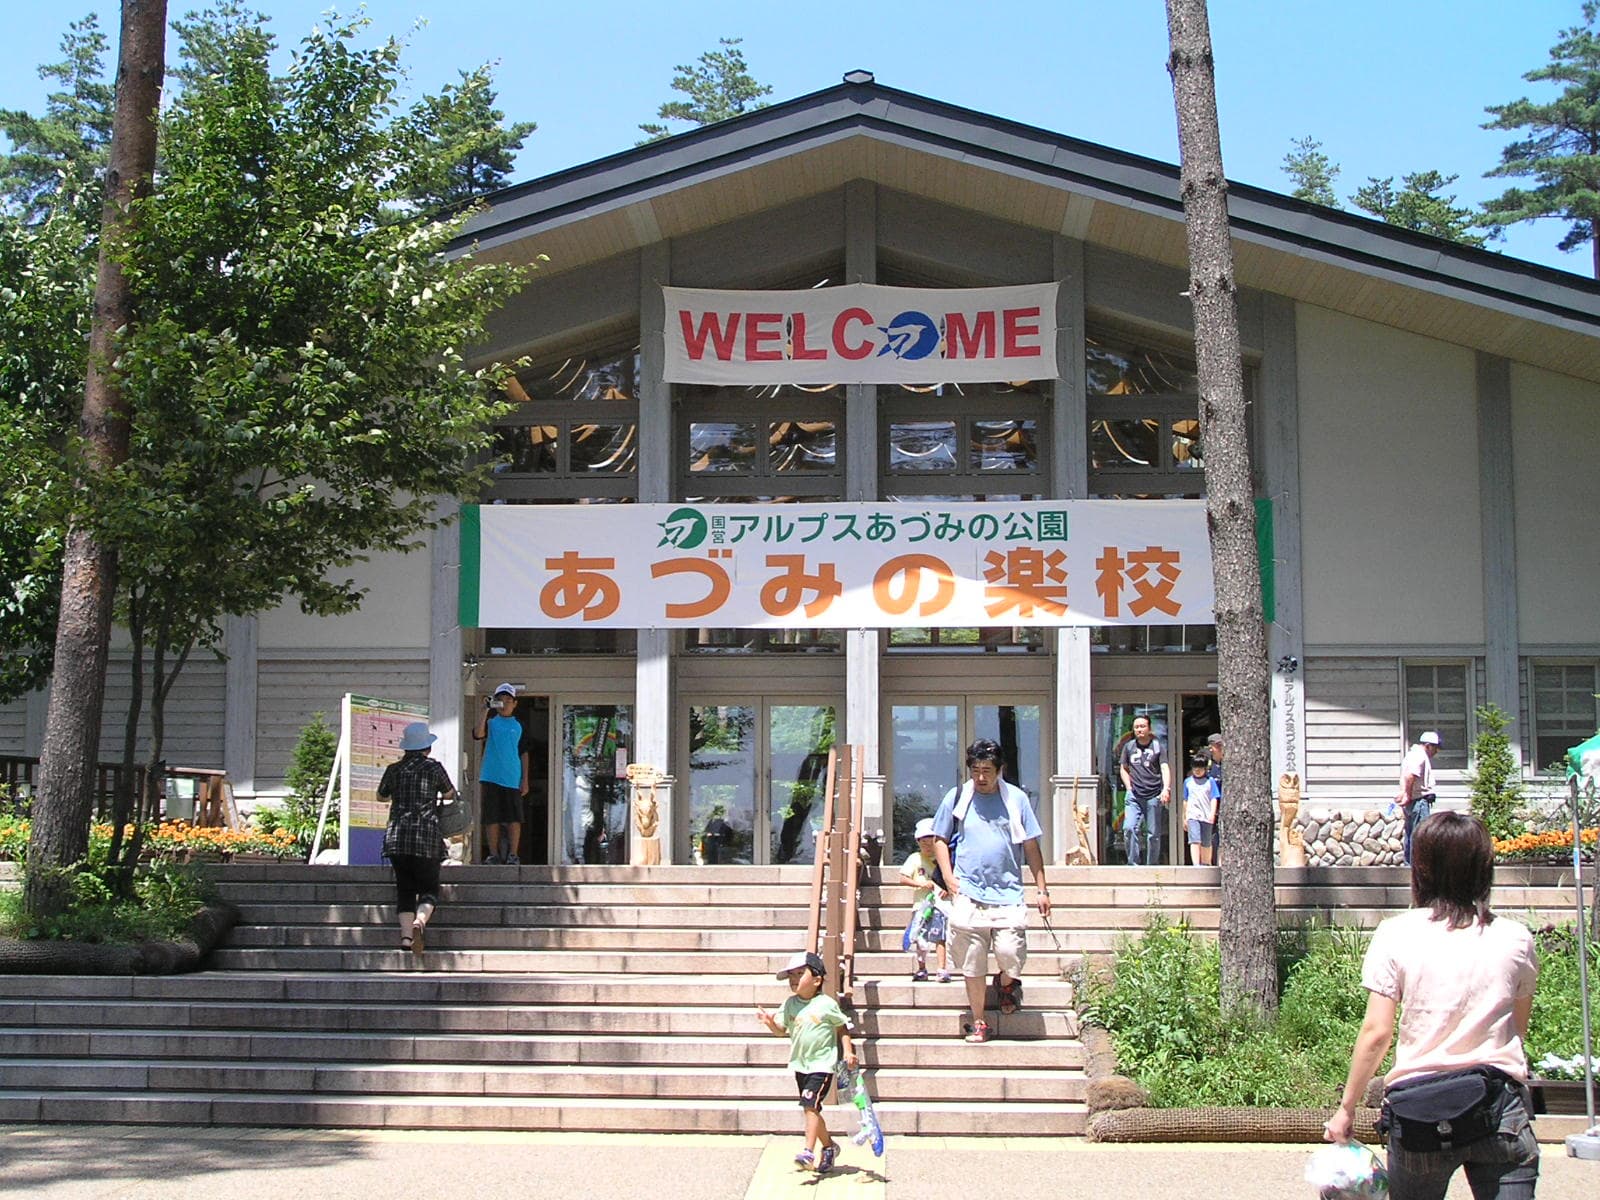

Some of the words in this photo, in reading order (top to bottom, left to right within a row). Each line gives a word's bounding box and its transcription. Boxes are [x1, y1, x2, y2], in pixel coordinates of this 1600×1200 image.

[539, 546, 1182, 621] あづみの楽校
